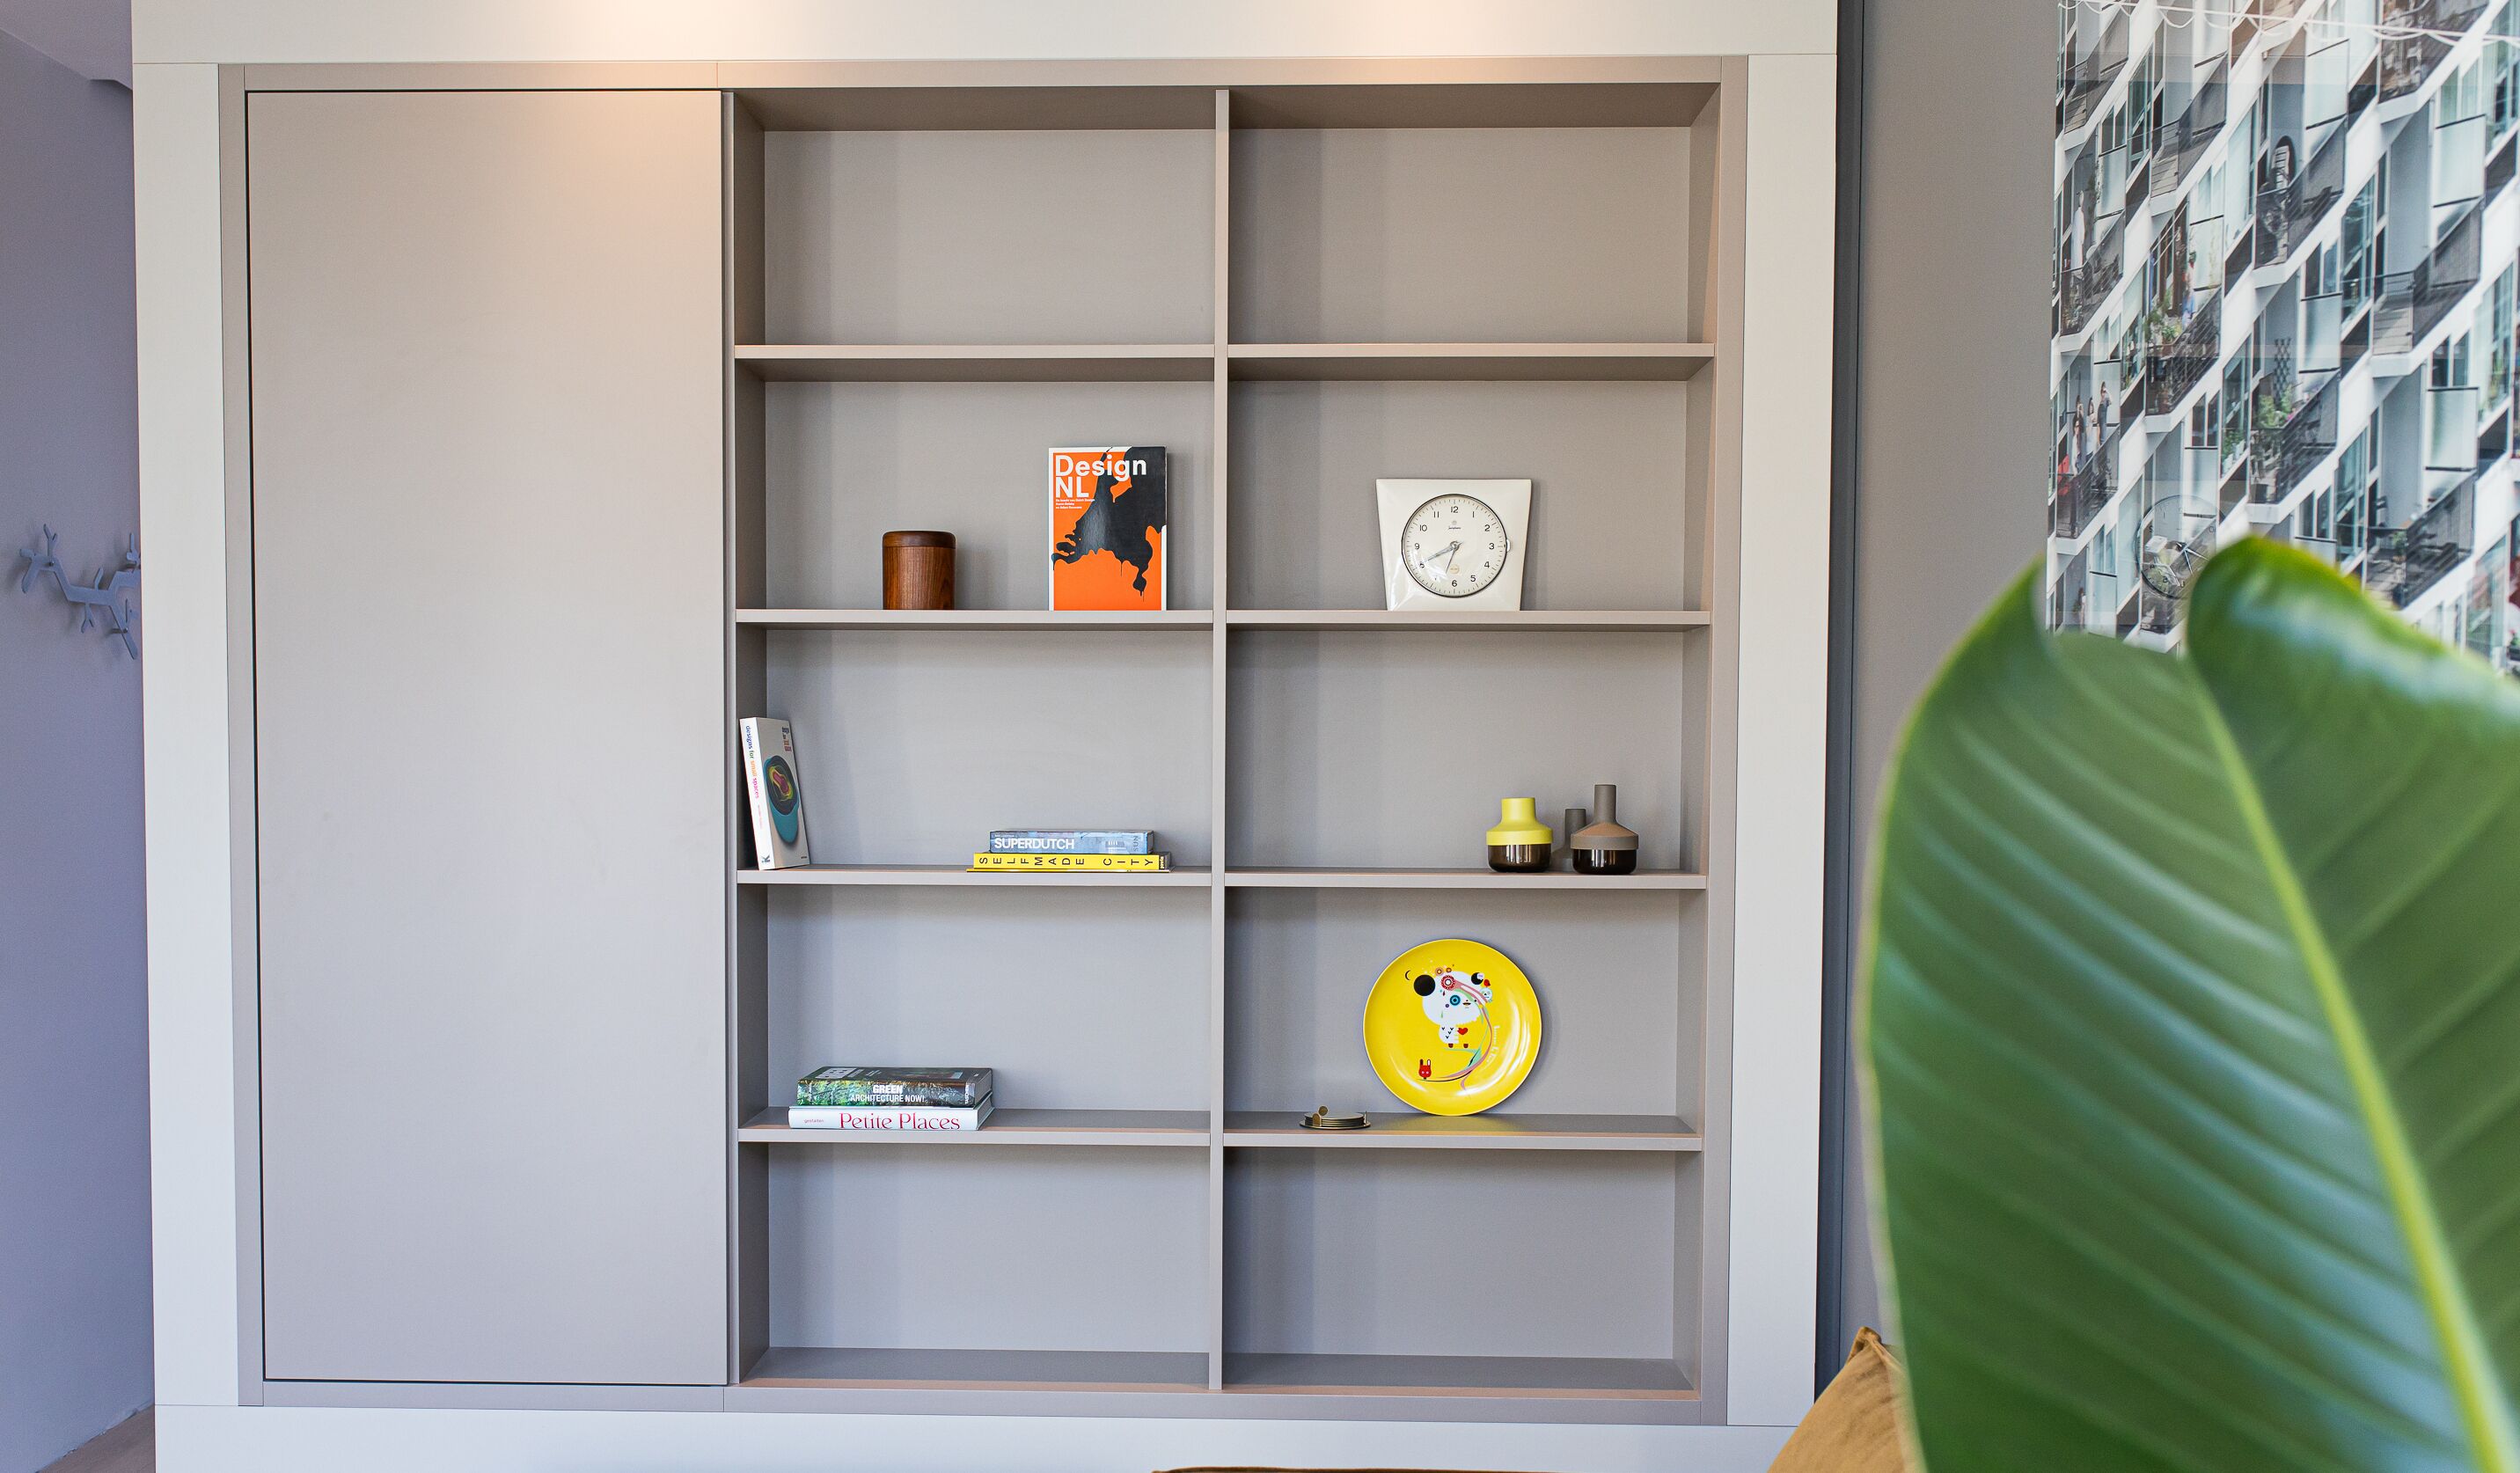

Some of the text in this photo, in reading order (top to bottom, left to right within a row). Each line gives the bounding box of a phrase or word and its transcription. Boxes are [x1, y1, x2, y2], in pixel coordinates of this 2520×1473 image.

[1056, 454, 1146, 481] Design
[1056, 476, 1089, 498] NL
[994, 838, 1074, 849] SUPERDUTCH
[979, 856, 1085, 866] SELFMADE
[873, 1084, 904, 1094] GREEN
[905, 1094, 925, 1103] NOW!
[839, 1112, 961, 1130] Petite Places
